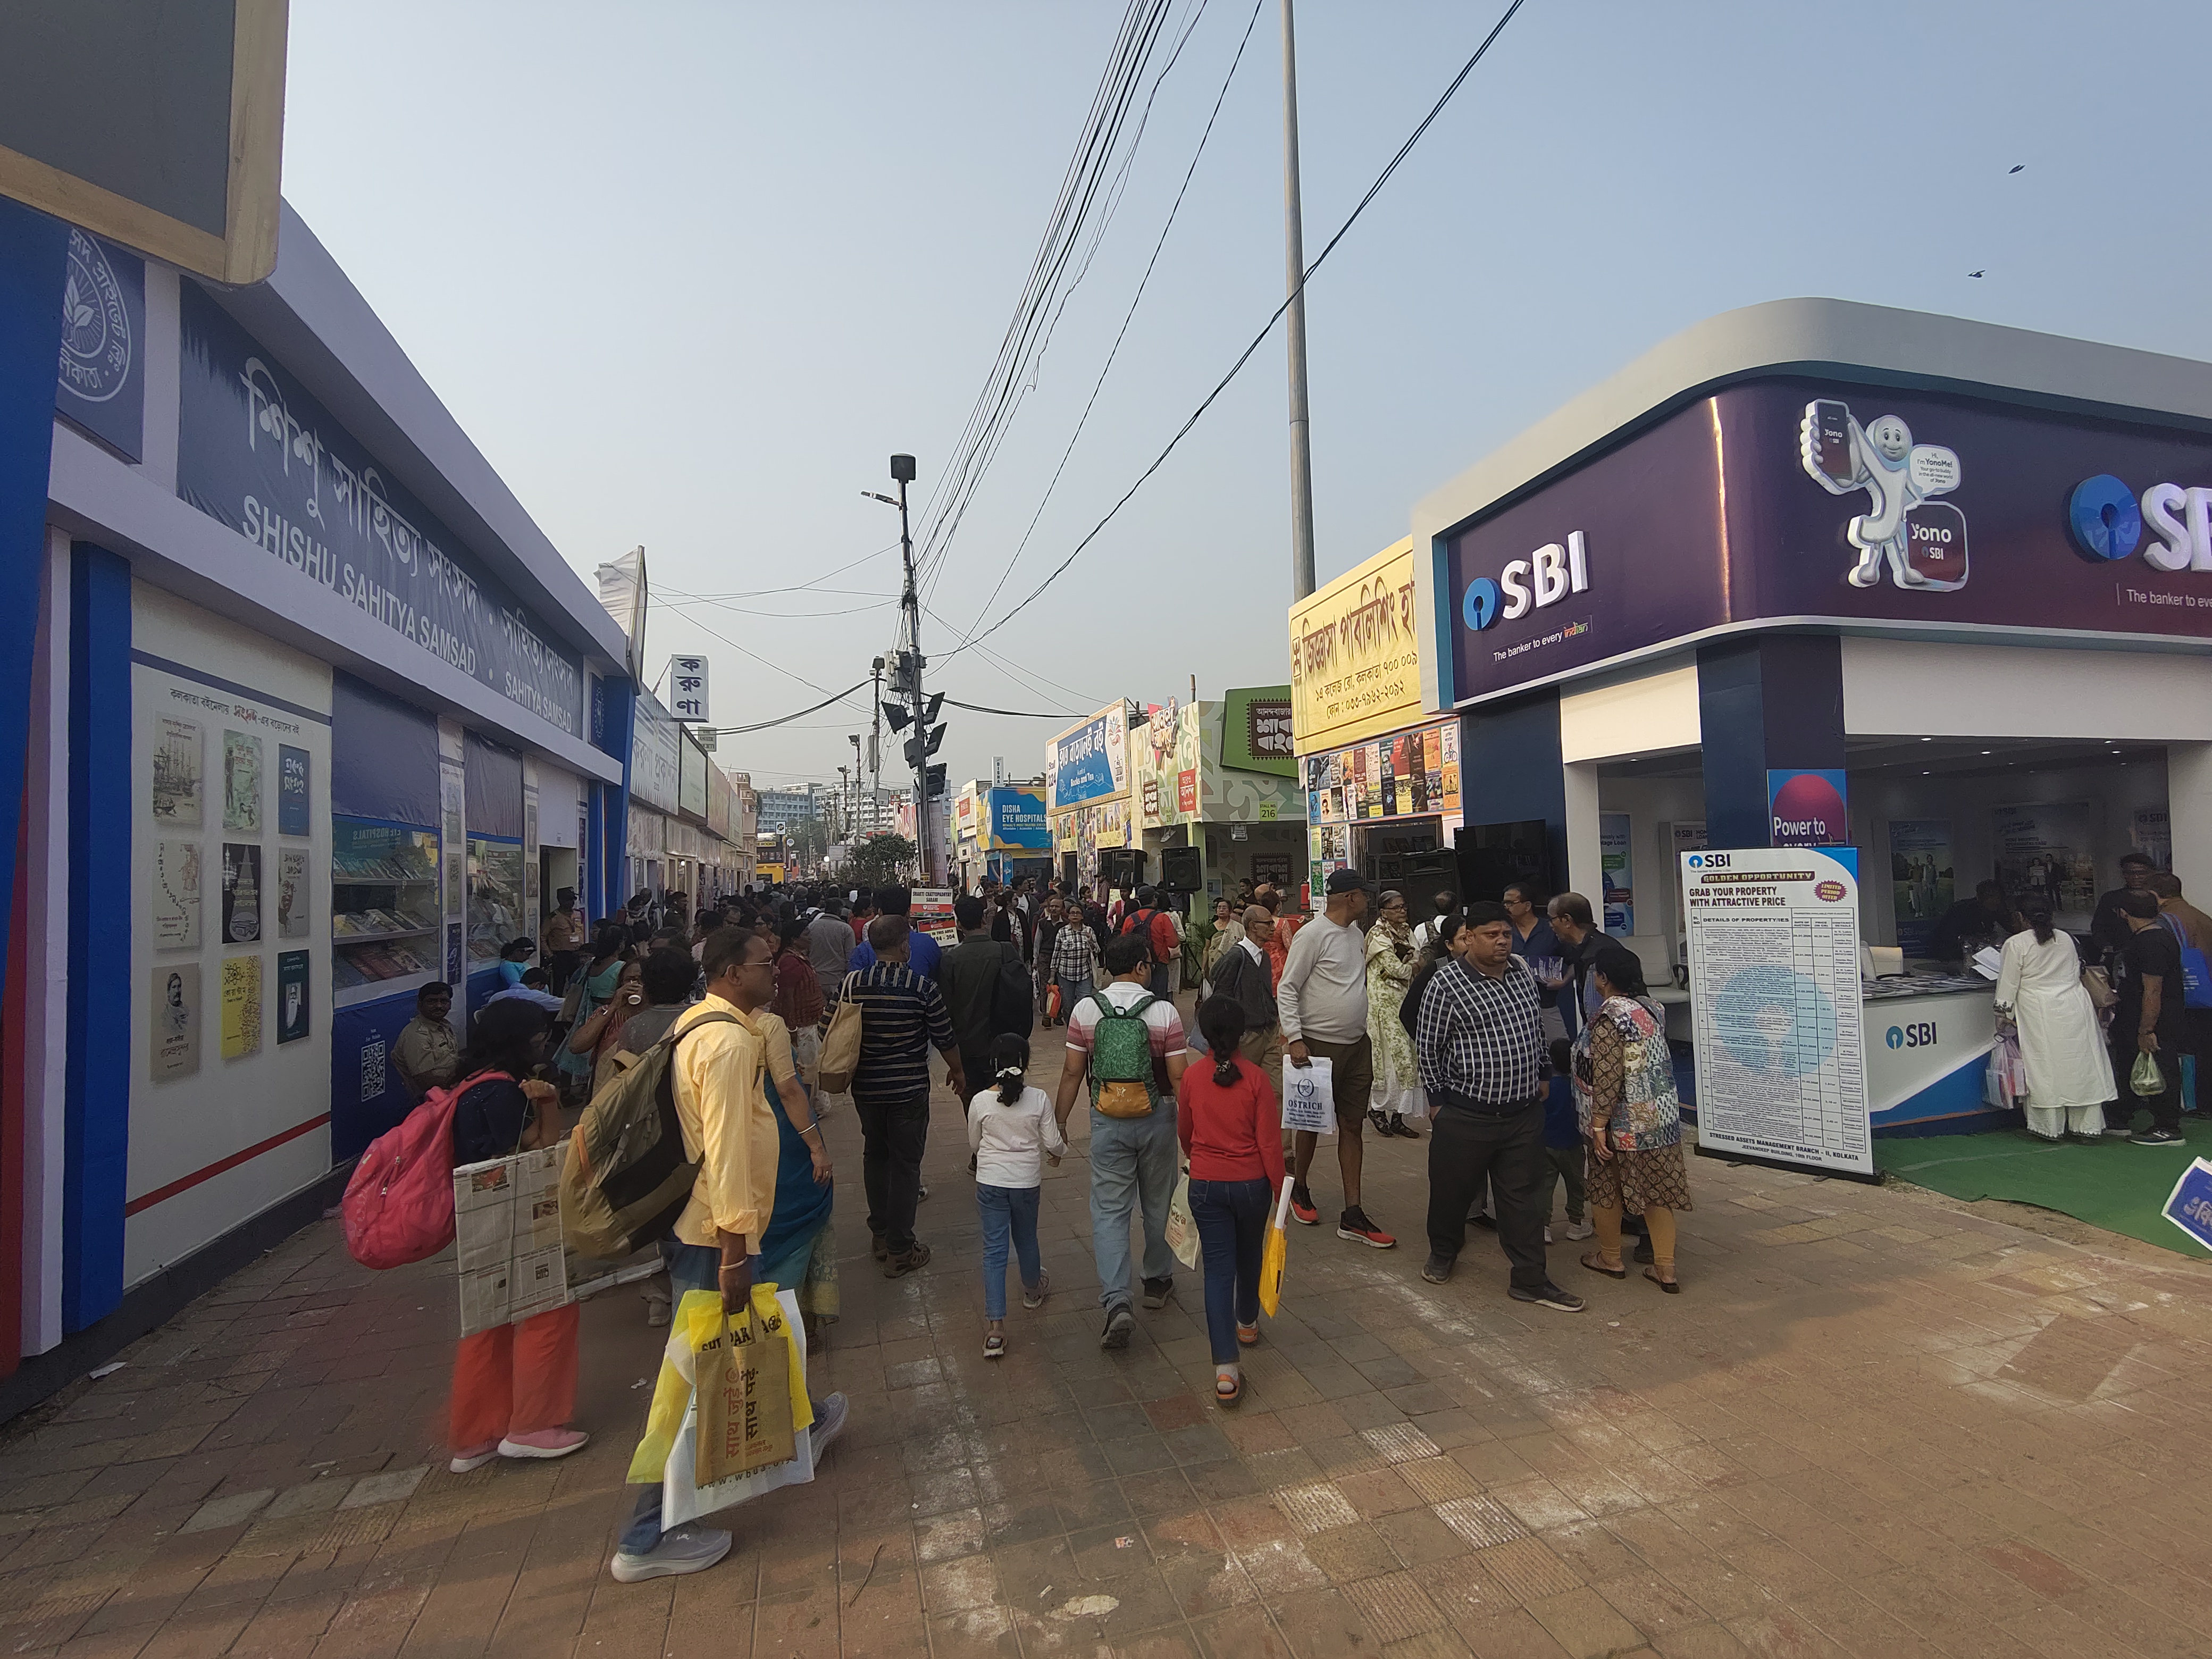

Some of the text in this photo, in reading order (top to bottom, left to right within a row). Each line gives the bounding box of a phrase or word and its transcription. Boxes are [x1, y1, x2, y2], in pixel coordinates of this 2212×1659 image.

[1925, 458, 1953, 468] YonoMe!
[239, 356, 478, 623] শিশু সাহিত্য সংসদ
[1929, 547, 1944, 560] SBI
[242, 495, 476, 677] SHISHU SAHITYA SAMSAD
[1501, 530, 1588, 620] SBI
[2126, 588, 2147, 603] The
[2149, 591, 2183, 606] banker
[2185, 595, 2196, 607] to
[1301, 576, 1399, 681] জিজ্ঞাসা পাবলিশিং
[500, 606, 573, 696] সাহিত্য সংসদ
[1493, 621, 1589, 663] The banker to every indian
[1324, 680, 1343, 699] কলেজ
[1355, 663, 1381, 687] কলকাতা
[1383, 659, 1399, 676] ৭০০
[1401, 650, 1418, 667] ০০৯
[676, 658, 702, 715] করুণা
[170, 688, 199, 708] কলকাতা
[233, 704, 257, 726] সংসদ
[292, 724, 301, 736] বই
[505, 671, 573, 733] SAHITYA SAMSAD
[1327, 701, 1340, 719] ফোন
[1059, 720, 1104, 770] হাত বাড়ালেই বই
[1070, 776, 1080, 787] Books
[1002, 805, 1021, 813] DISHA
[1016, 814, 1047, 823] HOSPITALS
[1774, 817, 1826, 836] Power to
[1705, 853, 1731, 868] SBI
[1703, 872, 1812, 883] GOLDEN OPPORTUNITY
[1689, 886, 1778, 897] GRAB YOUR PROPERTY
[1689, 896, 1786, 907] WITH ATTRACTIVE PRICE
[1906, 1021, 1937, 1048] SBI
[1288, 1099, 1323, 1110] OSTRICH
[1709, 1132, 1735, 1141] STRESSED
[1736, 1136, 1756, 1145] ASSETS
[1756, 1139, 1795, 1151] MANAGEMENT
[1796, 1145, 1819, 1154] BRANCH
[1832, 1151, 1859, 1161] KOLKATA
[1741, 1144, 1770, 1153] JEEVANDEEP
[1771, 1148, 1794, 1157] BUILDING,
[745, 1401, 759, 1441] साथ
